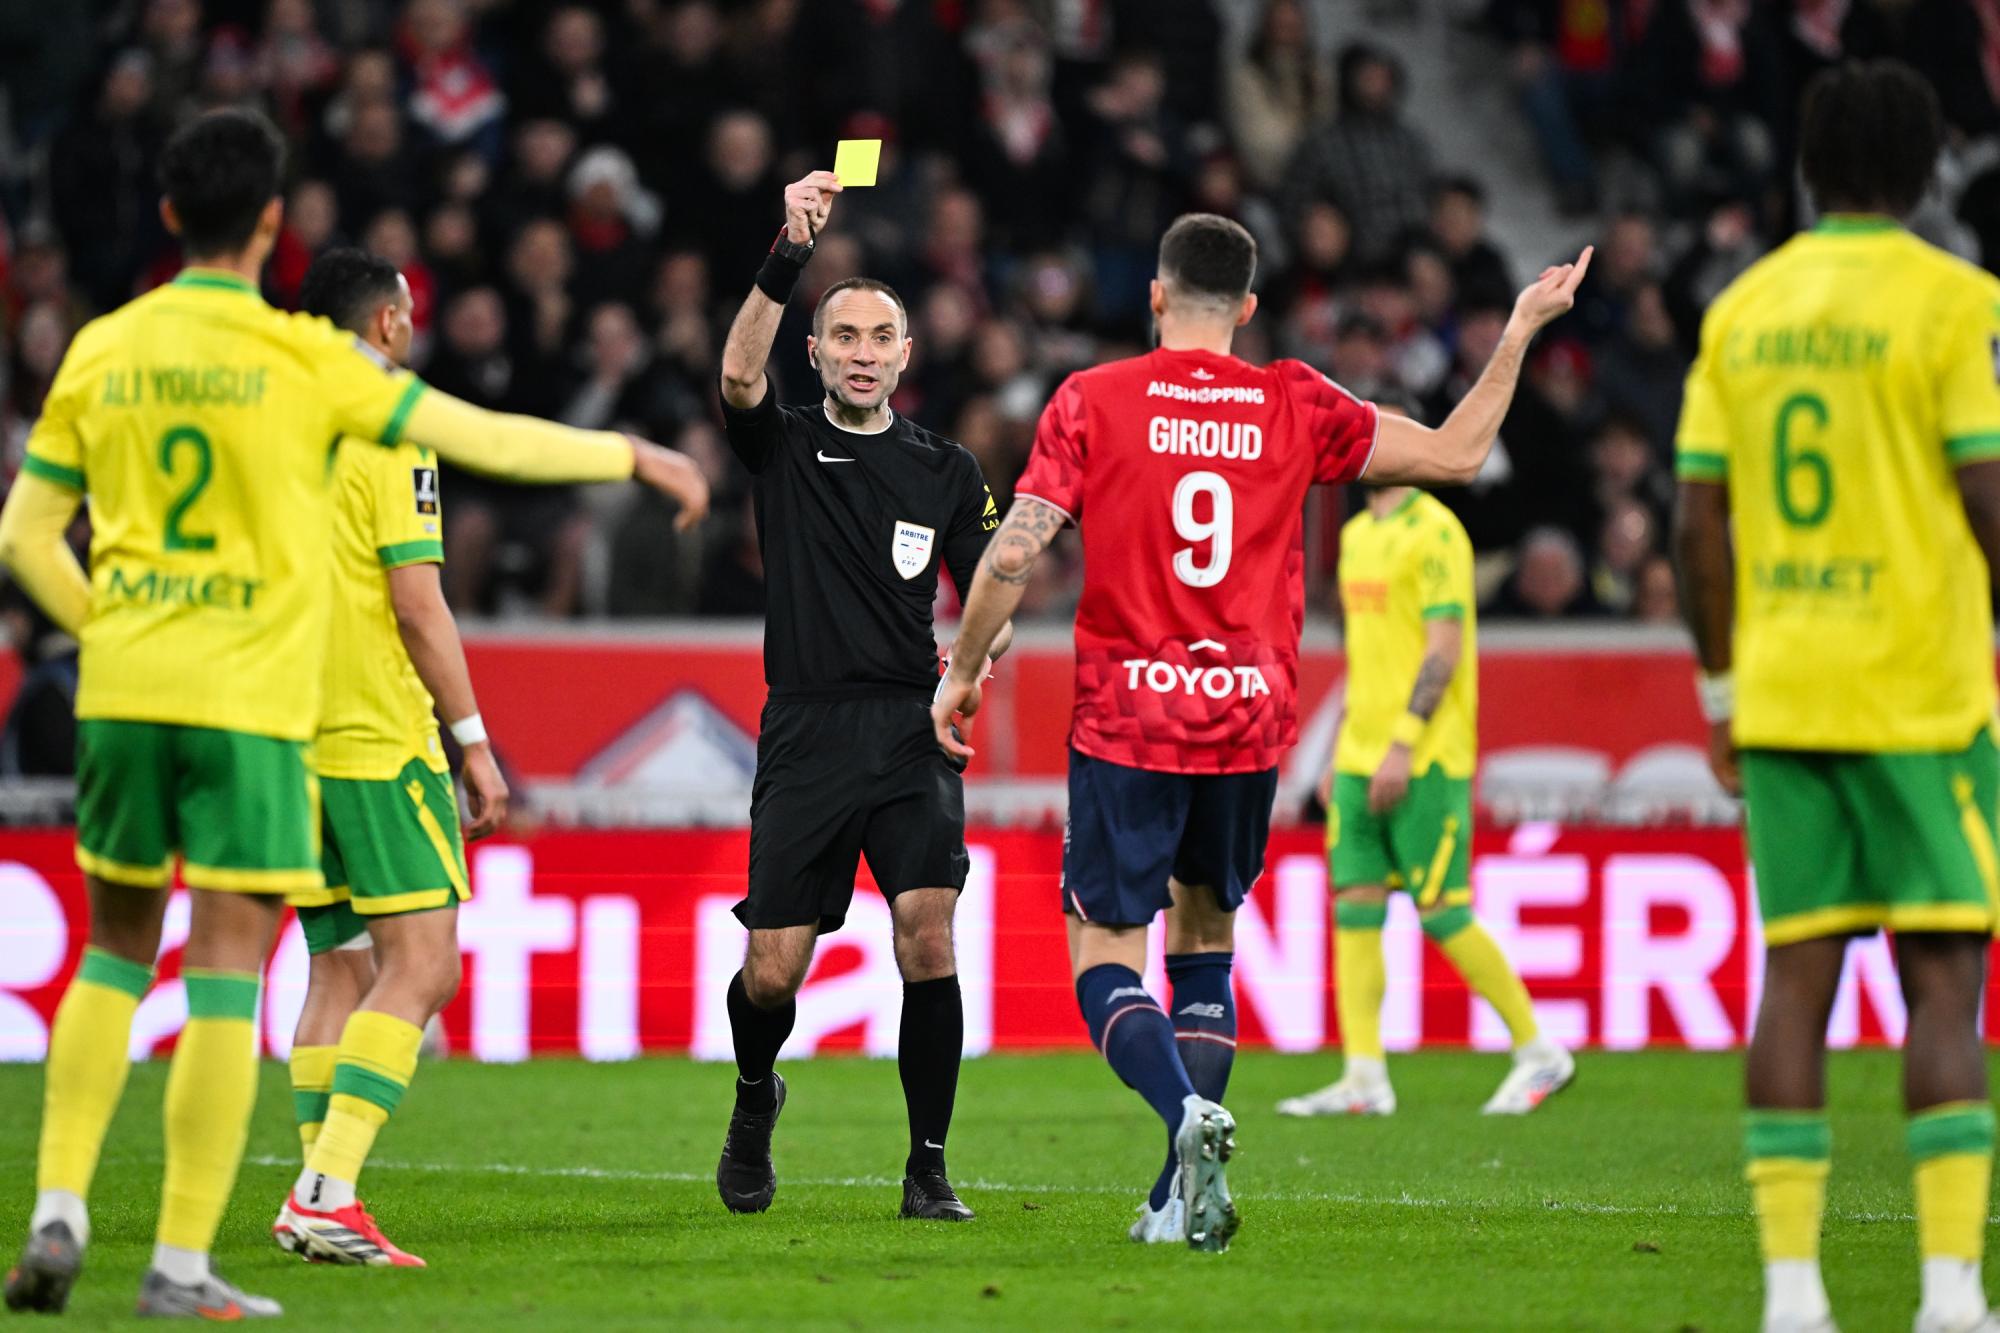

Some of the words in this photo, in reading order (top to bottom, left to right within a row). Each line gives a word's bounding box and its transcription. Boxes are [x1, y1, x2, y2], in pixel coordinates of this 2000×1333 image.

[1146, 380, 1265, 405] AUSHOPPING
[1148, 415, 1263, 461] GIROUD
[1774, 392, 1834, 529] 6
[158, 426, 217, 552] 2
[900, 529, 929, 542] ARBITRE
[1172, 470, 1234, 588] 9
[1123, 658, 1270, 699] TOYOTA
